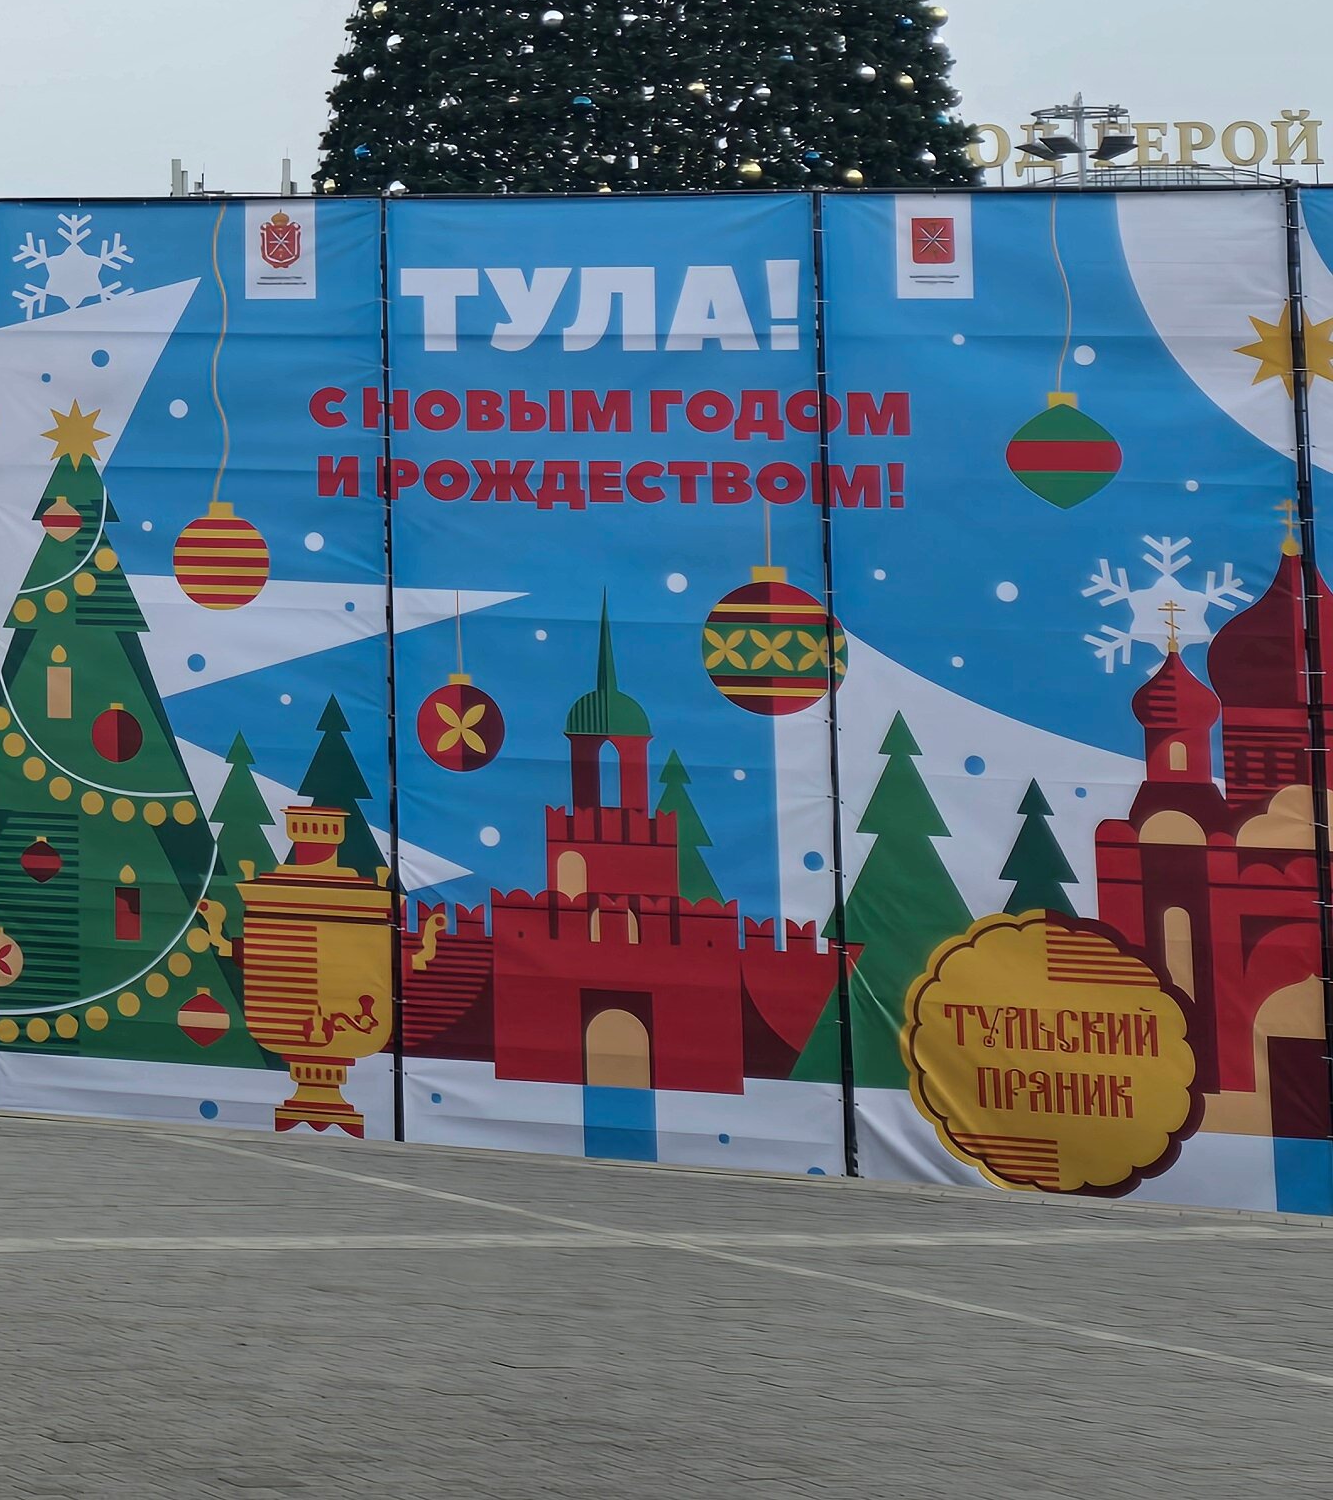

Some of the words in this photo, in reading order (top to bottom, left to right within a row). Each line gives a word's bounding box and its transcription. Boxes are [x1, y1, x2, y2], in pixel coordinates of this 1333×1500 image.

[400, 259, 800, 352] ТУЛА!
[308, 387, 347, 428] С
[362, 387, 631, 432] НОВЫМ
[649, 389, 911, 441] ГОДОМ
[317, 456, 359, 498] И
[376, 457, 906, 510] РОЖДЕСТВОМ!
[943, 1003, 1159, 1058] ТУЛЬСКИЙ
[976, 1066, 1134, 1119] ПРЯНИК
